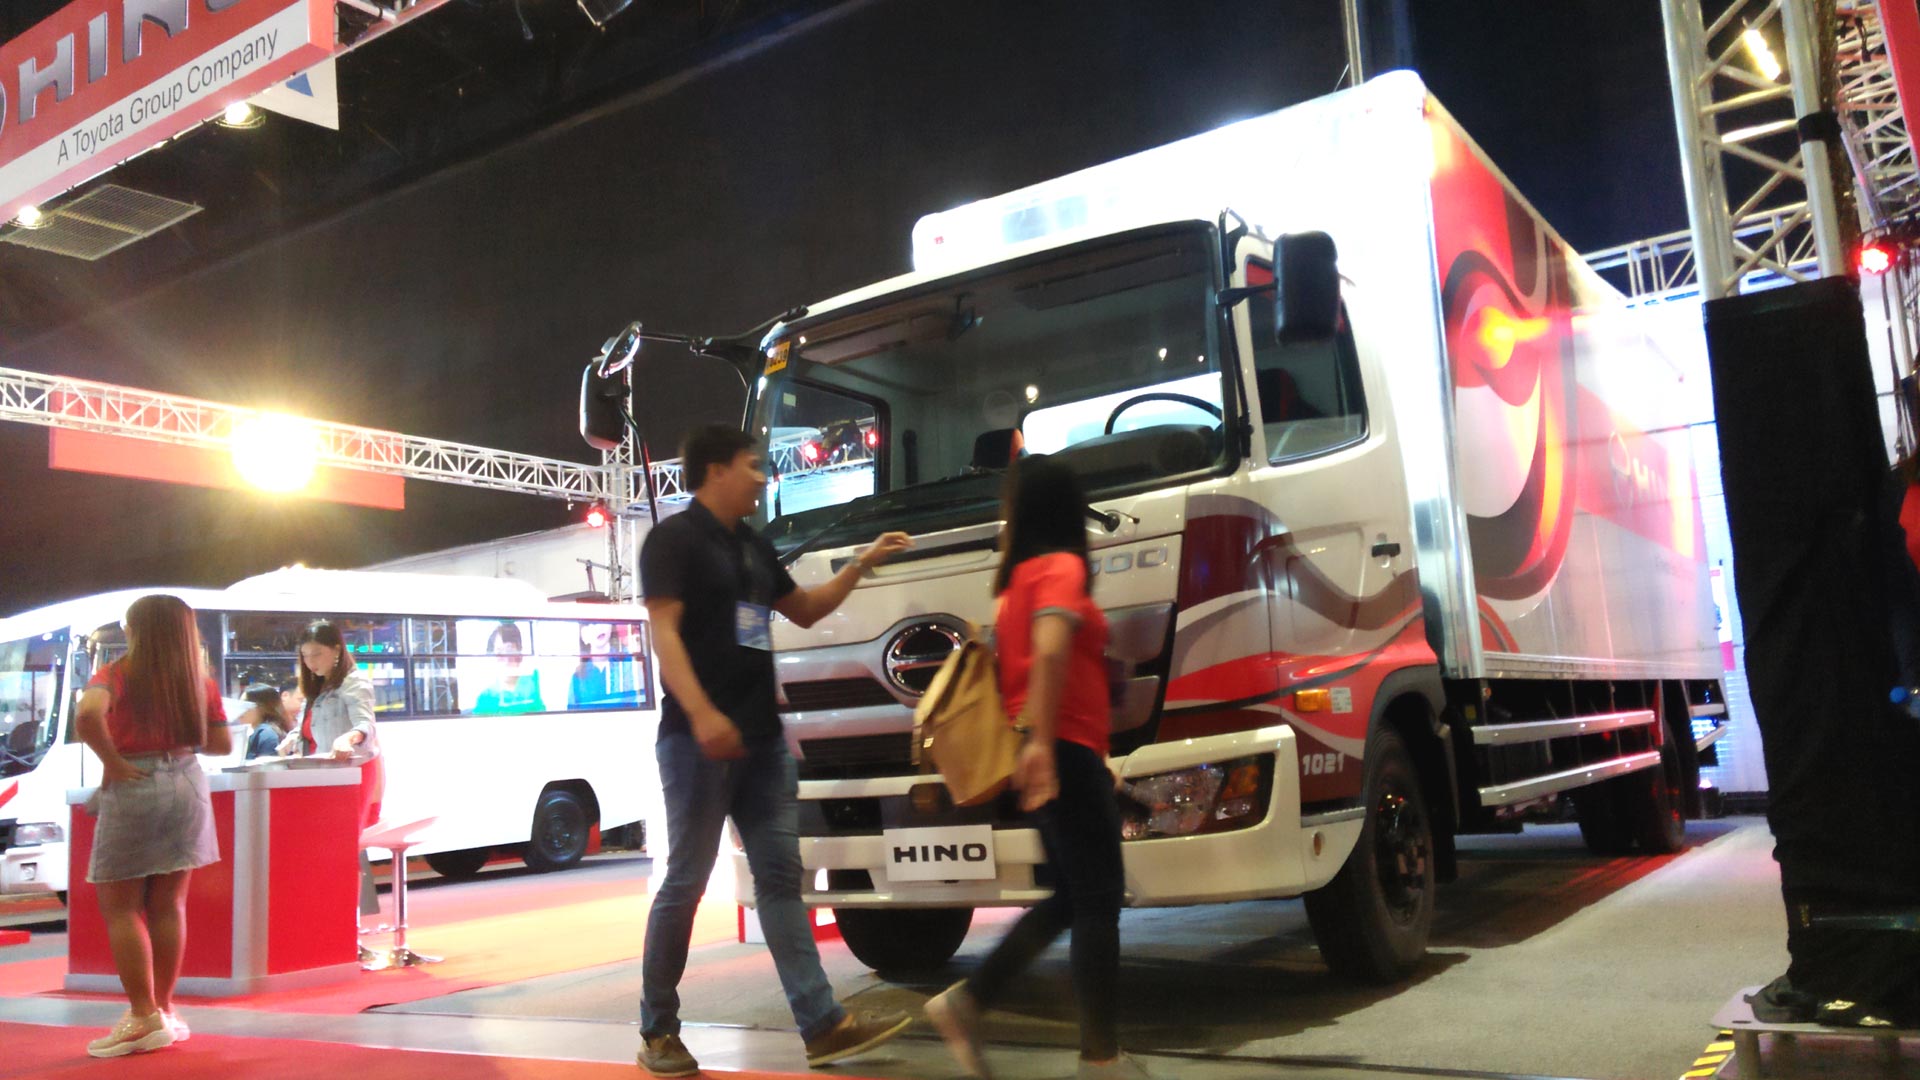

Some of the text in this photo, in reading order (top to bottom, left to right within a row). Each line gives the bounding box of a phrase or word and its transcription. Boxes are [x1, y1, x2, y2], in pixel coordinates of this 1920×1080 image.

[18, 0, 243, 124] HIN
[58, 29, 278, 165] A Toyota Group Company
[1303, 752, 1345, 776] 1021
[893, 843, 987, 863] HINO
